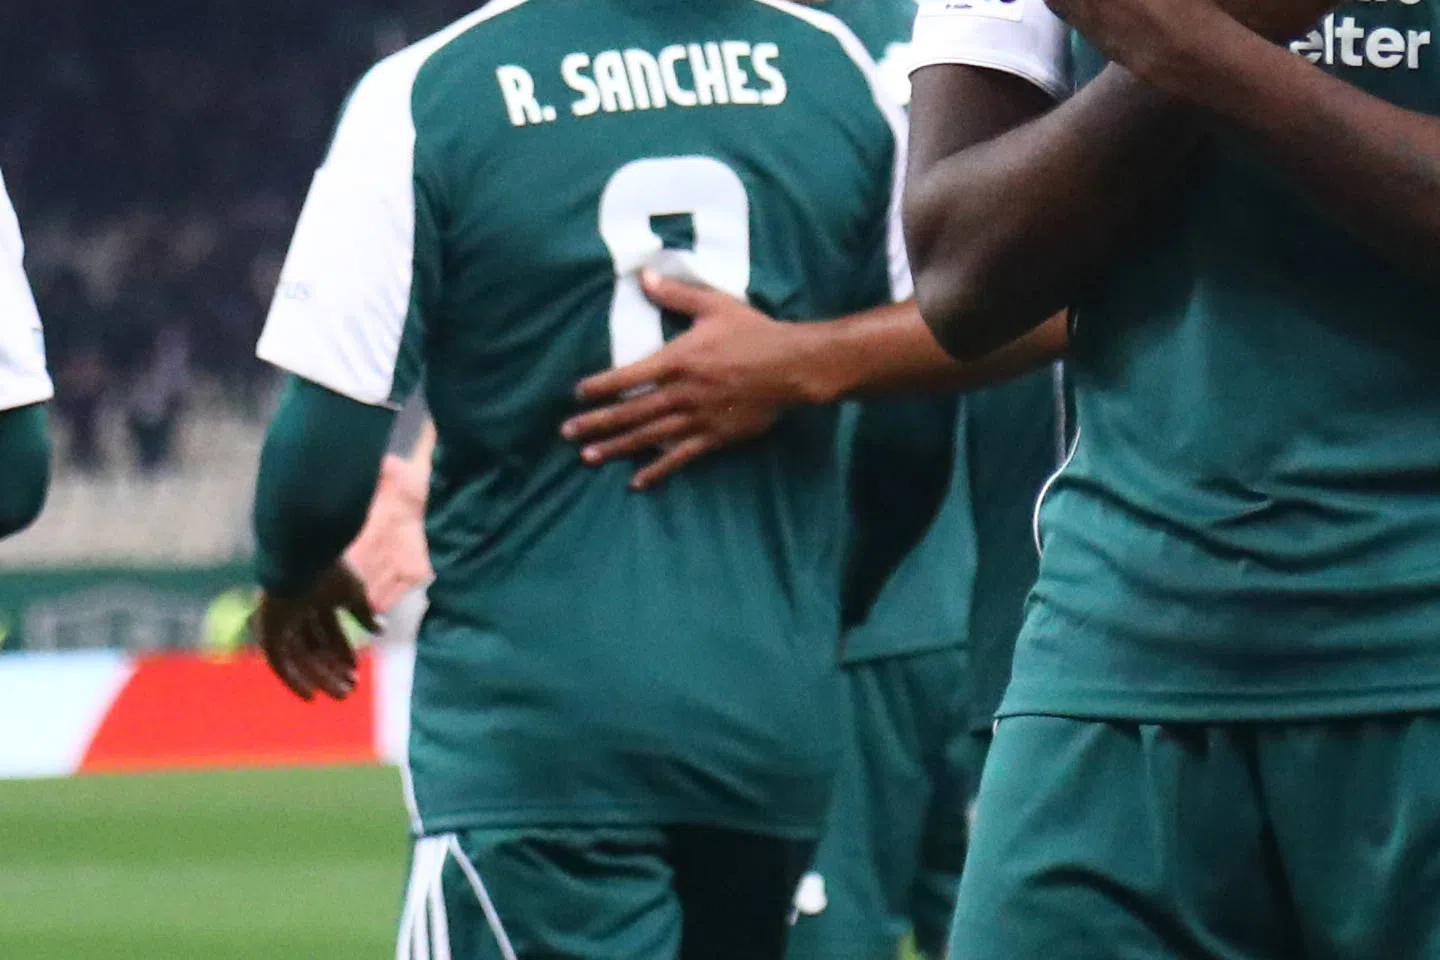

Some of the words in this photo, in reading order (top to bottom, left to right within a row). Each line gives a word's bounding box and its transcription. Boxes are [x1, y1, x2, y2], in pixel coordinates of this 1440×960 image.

[1288, 12, 1431, 70] elter
[496, 64, 557, 127] R.
[560, 41, 788, 117] SANCHES
